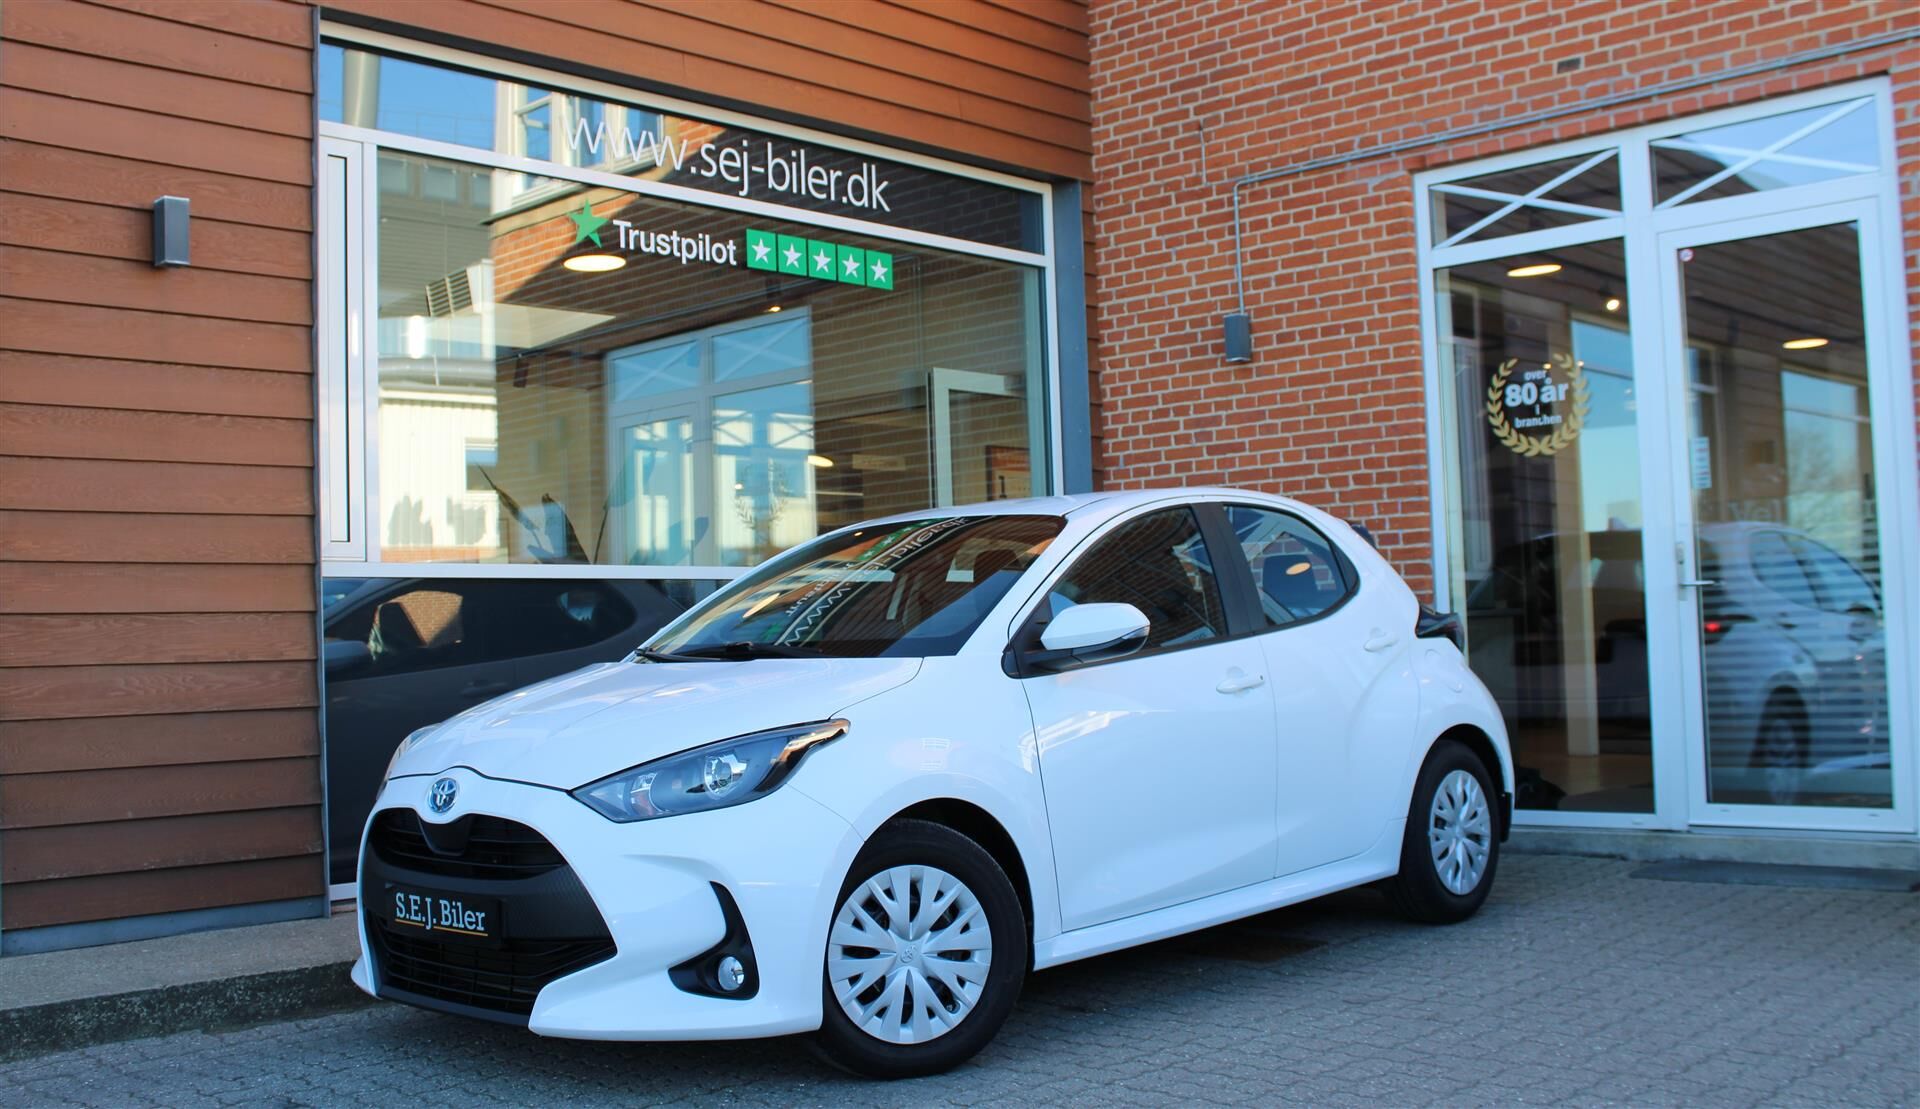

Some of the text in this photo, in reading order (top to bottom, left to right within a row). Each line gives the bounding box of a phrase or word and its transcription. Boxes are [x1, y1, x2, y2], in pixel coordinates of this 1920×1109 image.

[561, 112, 892, 213] www.sej-biler.dk
[612, 219, 737, 266] Trustpilot
[1505, 377, 1569, 407] 80 år
[1523, 370, 1547, 381] over
[1514, 415, 1563, 429] branchen
[395, 892, 486, 931] S.E.J. Biler
